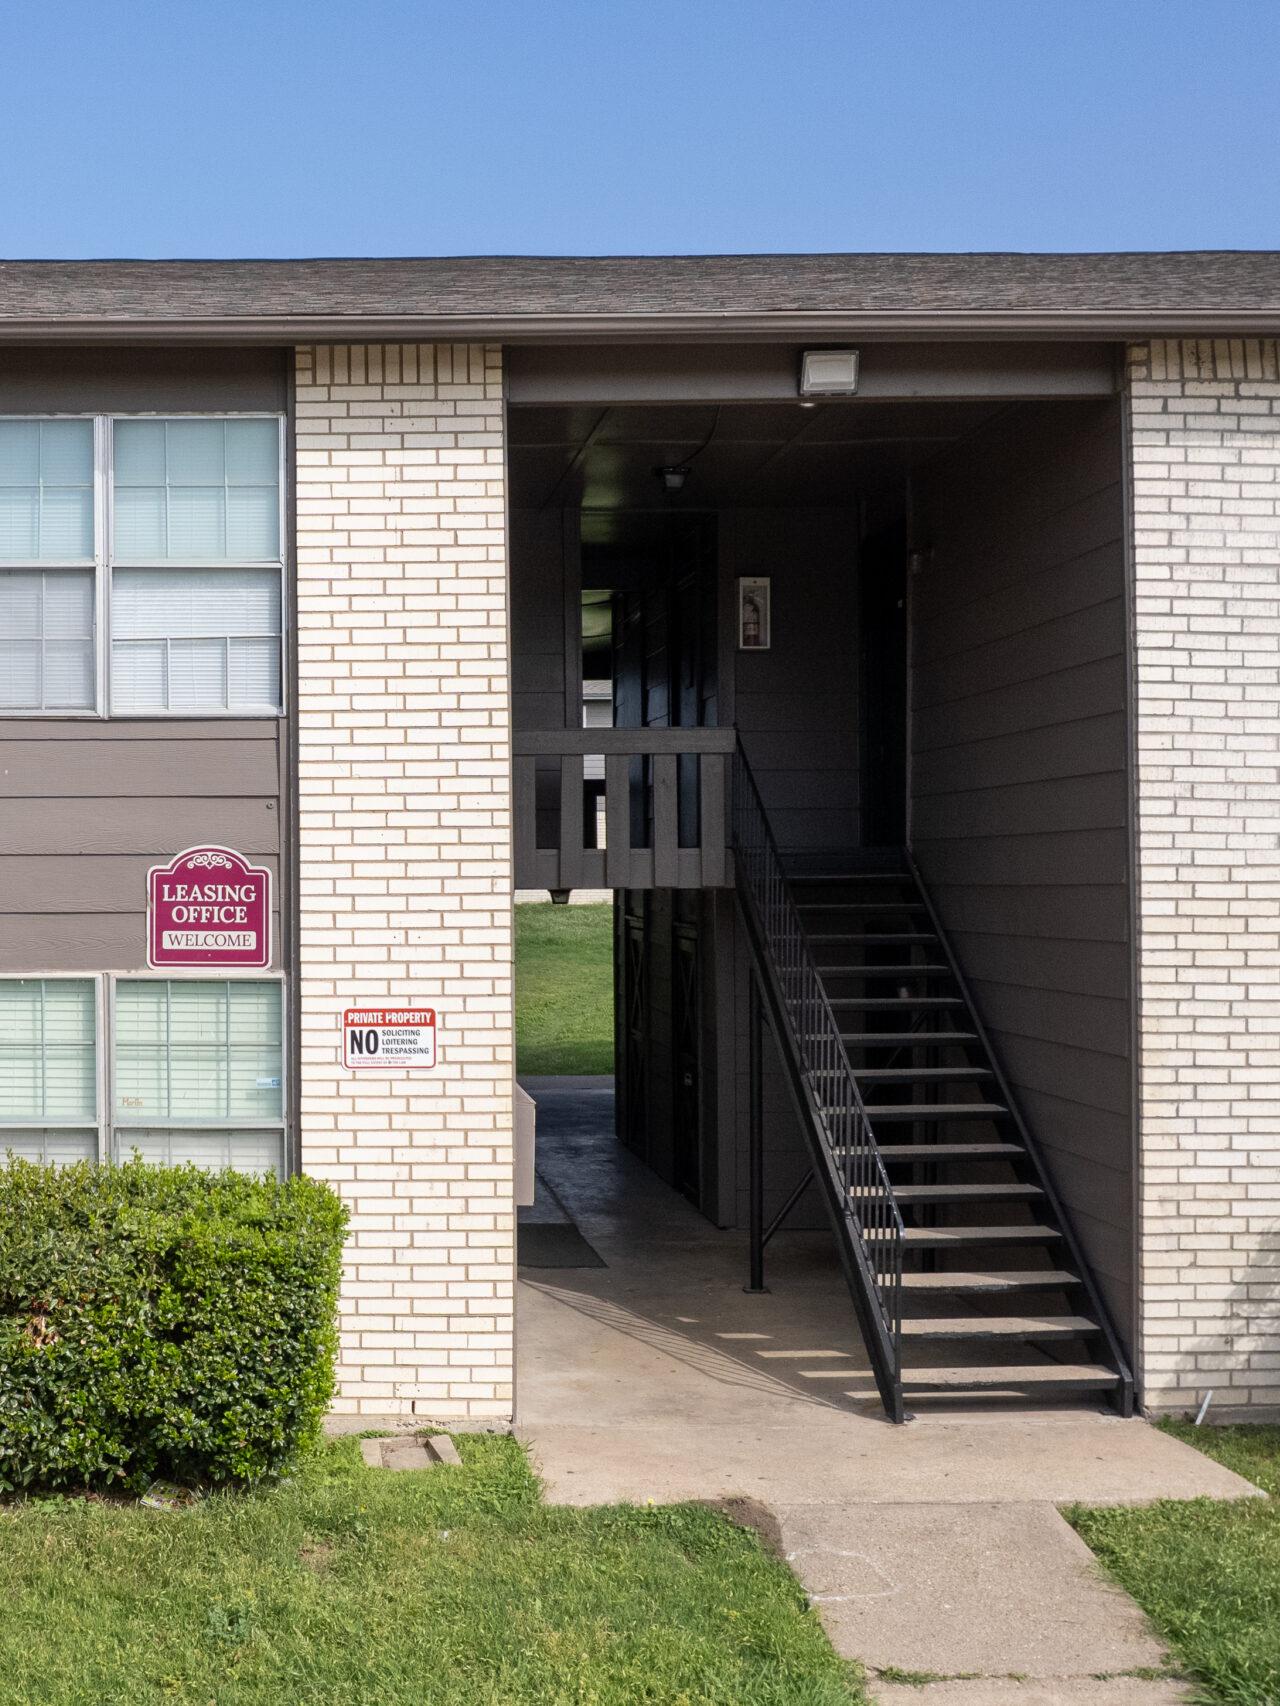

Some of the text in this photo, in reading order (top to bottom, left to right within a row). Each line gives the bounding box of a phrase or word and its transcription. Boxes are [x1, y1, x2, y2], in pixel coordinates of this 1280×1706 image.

[162, 884, 256, 902] LEASING
[171, 905, 248, 924] OFFICE
[167, 933, 252, 947] WELCOME
[347, 1012, 432, 1024] PRIVATE PROPERTY
[381, 1029, 421, 1037] SOLICITING
[350, 1029, 379, 1055] NO
[381, 1047, 430, 1055] TRESPASSING
